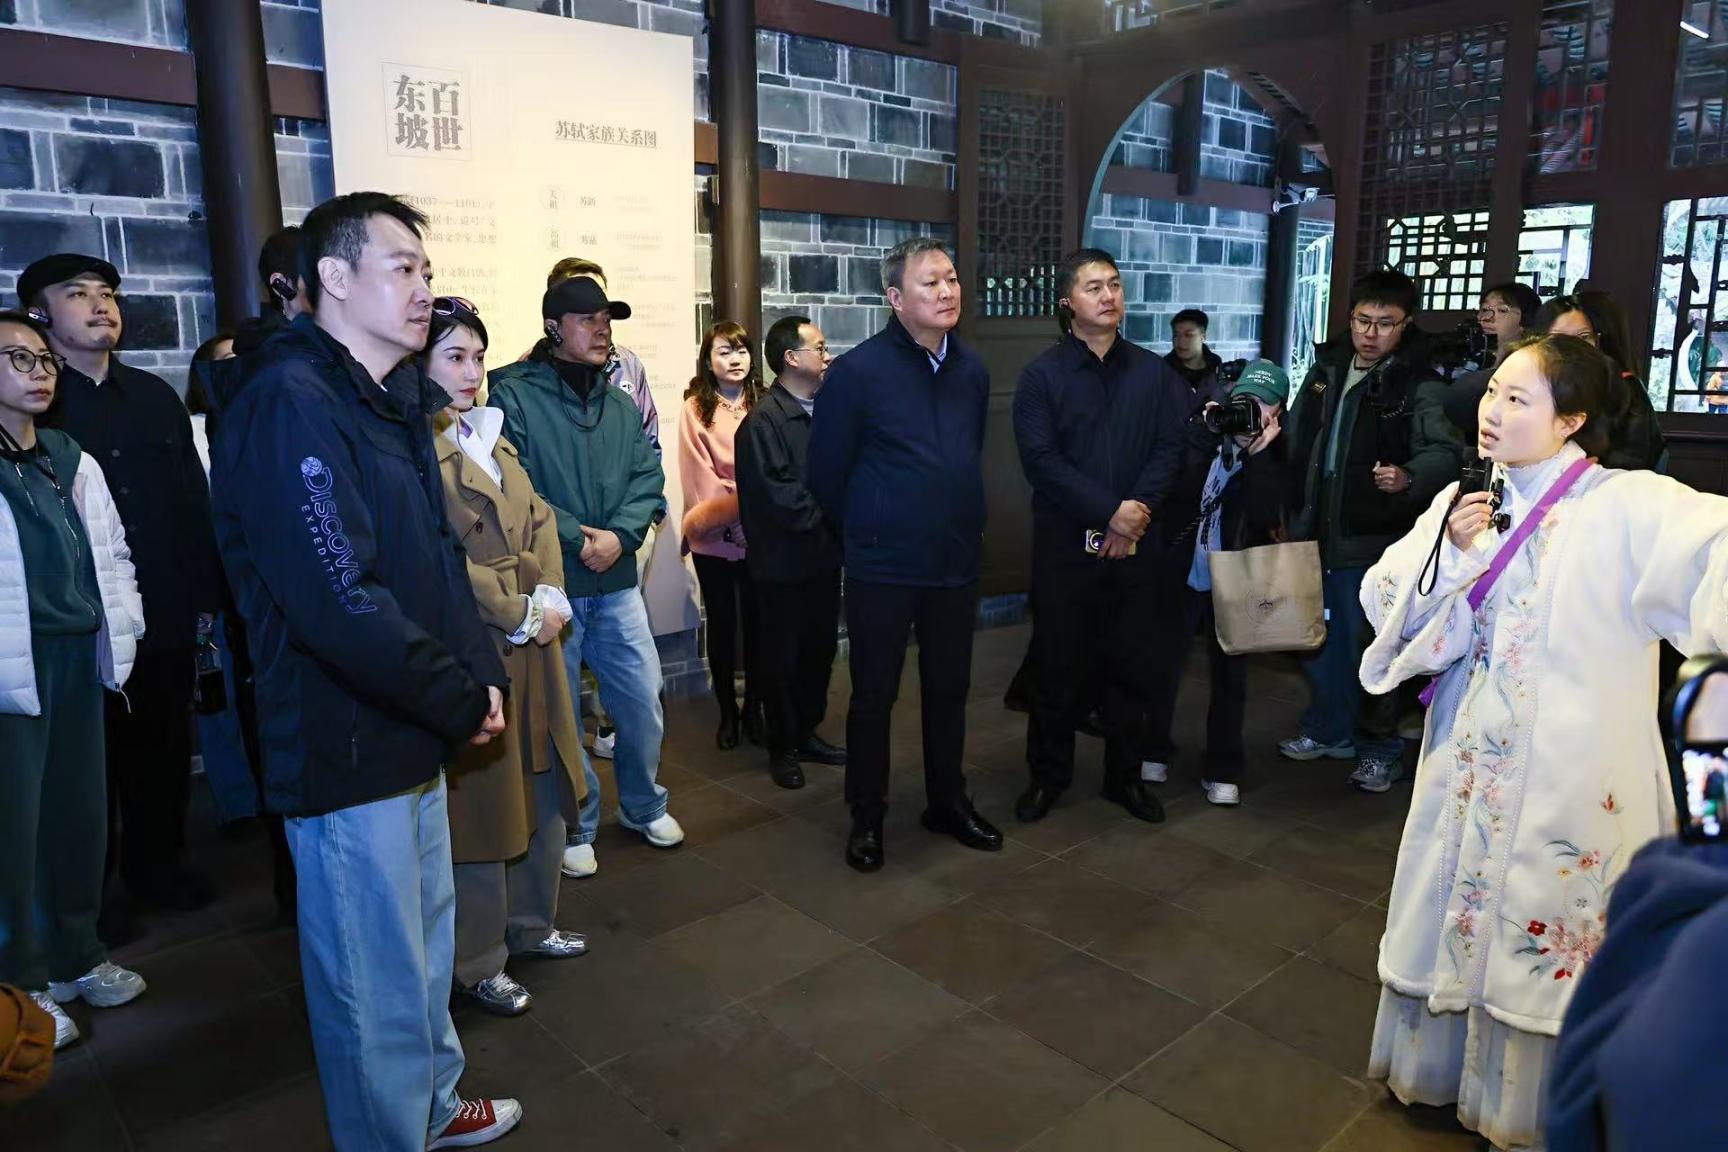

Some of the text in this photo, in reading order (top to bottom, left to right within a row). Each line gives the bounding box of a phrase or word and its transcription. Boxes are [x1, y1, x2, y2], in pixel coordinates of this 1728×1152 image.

[555, 119, 657, 148] 苏轼家族关系图
[301, 504, 347, 604] EXPEDITION
